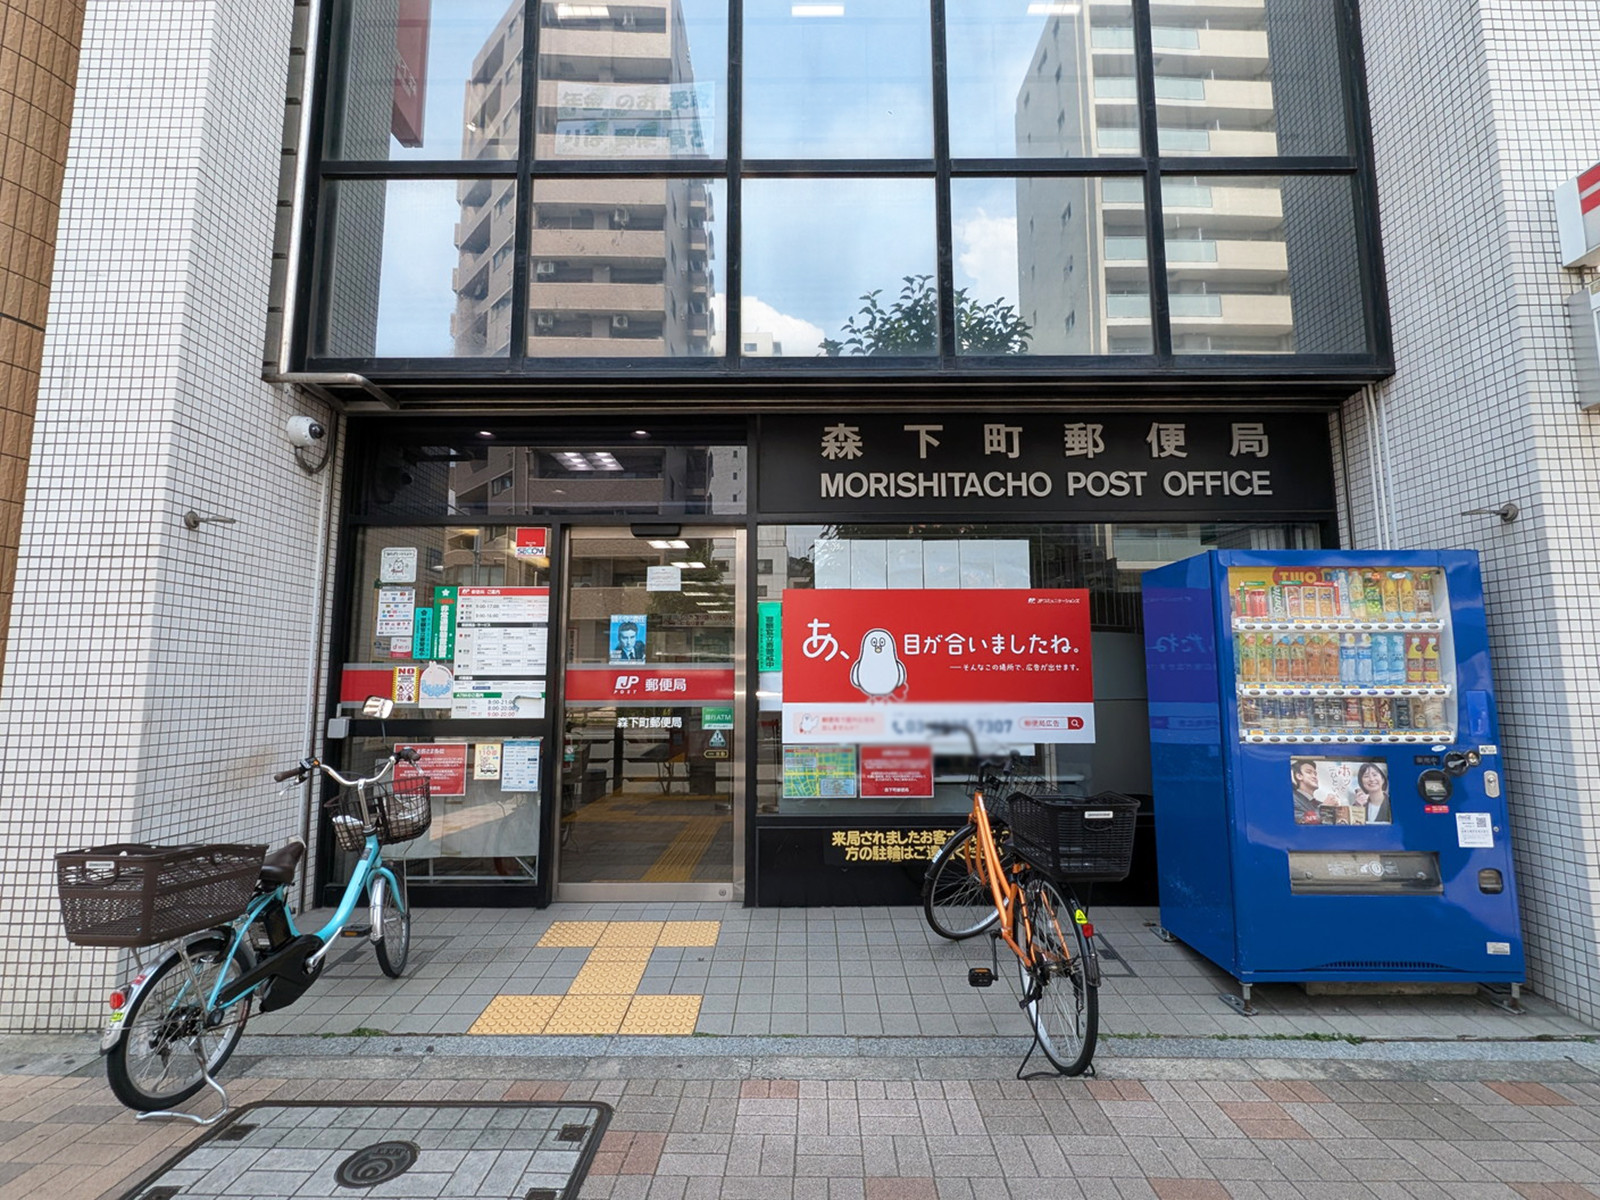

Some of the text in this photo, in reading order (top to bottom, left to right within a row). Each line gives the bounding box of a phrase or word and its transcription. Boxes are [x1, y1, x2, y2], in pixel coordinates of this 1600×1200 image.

[820, 422, 1269, 460] 森下町郵便局
[820, 470, 1273, 498] MORISHITACHO POST OFFICE
[1271, 585, 1284, 613] Sprite
[802, 618, 1080, 661] あ、 目が合いましたね。
[645, 678, 687, 692] 郵便局
[617, 717, 682, 728] 森下町郵便局
